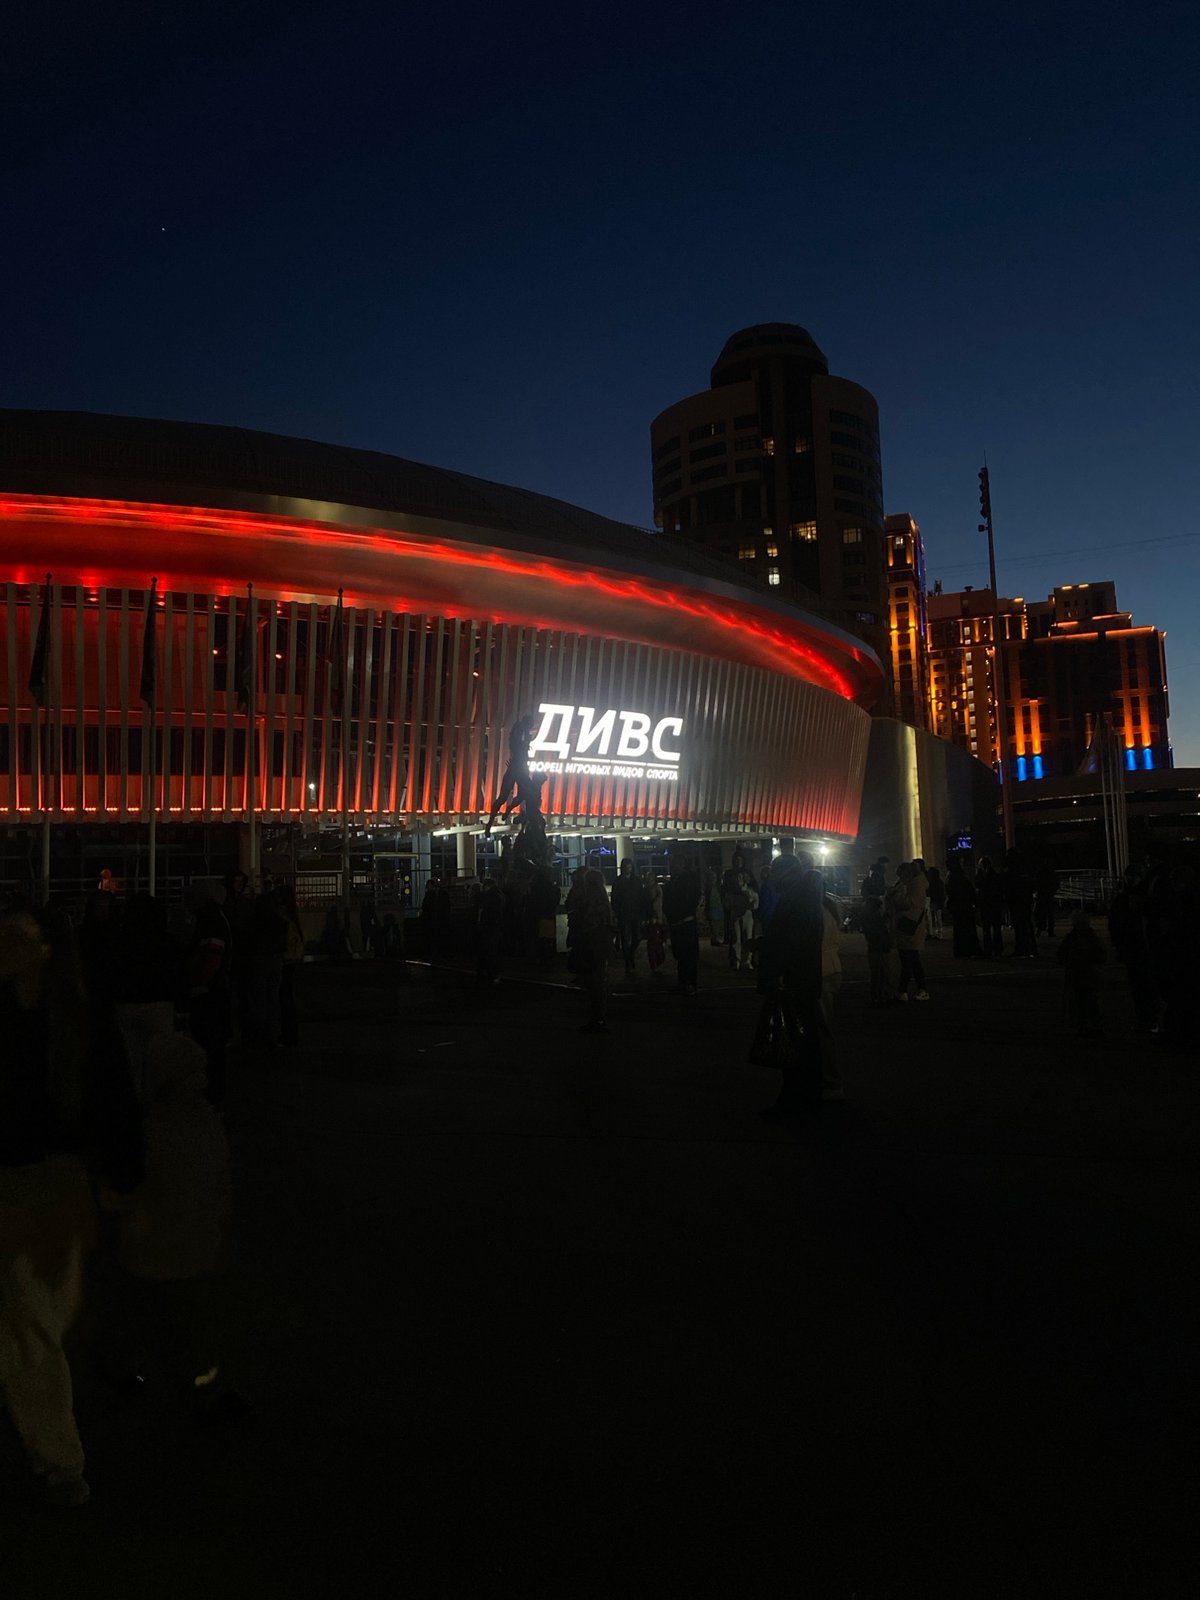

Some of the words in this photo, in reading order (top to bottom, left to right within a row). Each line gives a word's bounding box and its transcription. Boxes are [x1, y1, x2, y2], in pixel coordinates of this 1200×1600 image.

[528, 703, 683, 761] ДИВС
[527, 761, 563, 774] ВОРЕЦ
[565, 764, 611, 776] ИГРОВЫХ
[613, 767, 644, 779] ВИДОВ
[646, 769, 679, 781] СПОРТА
